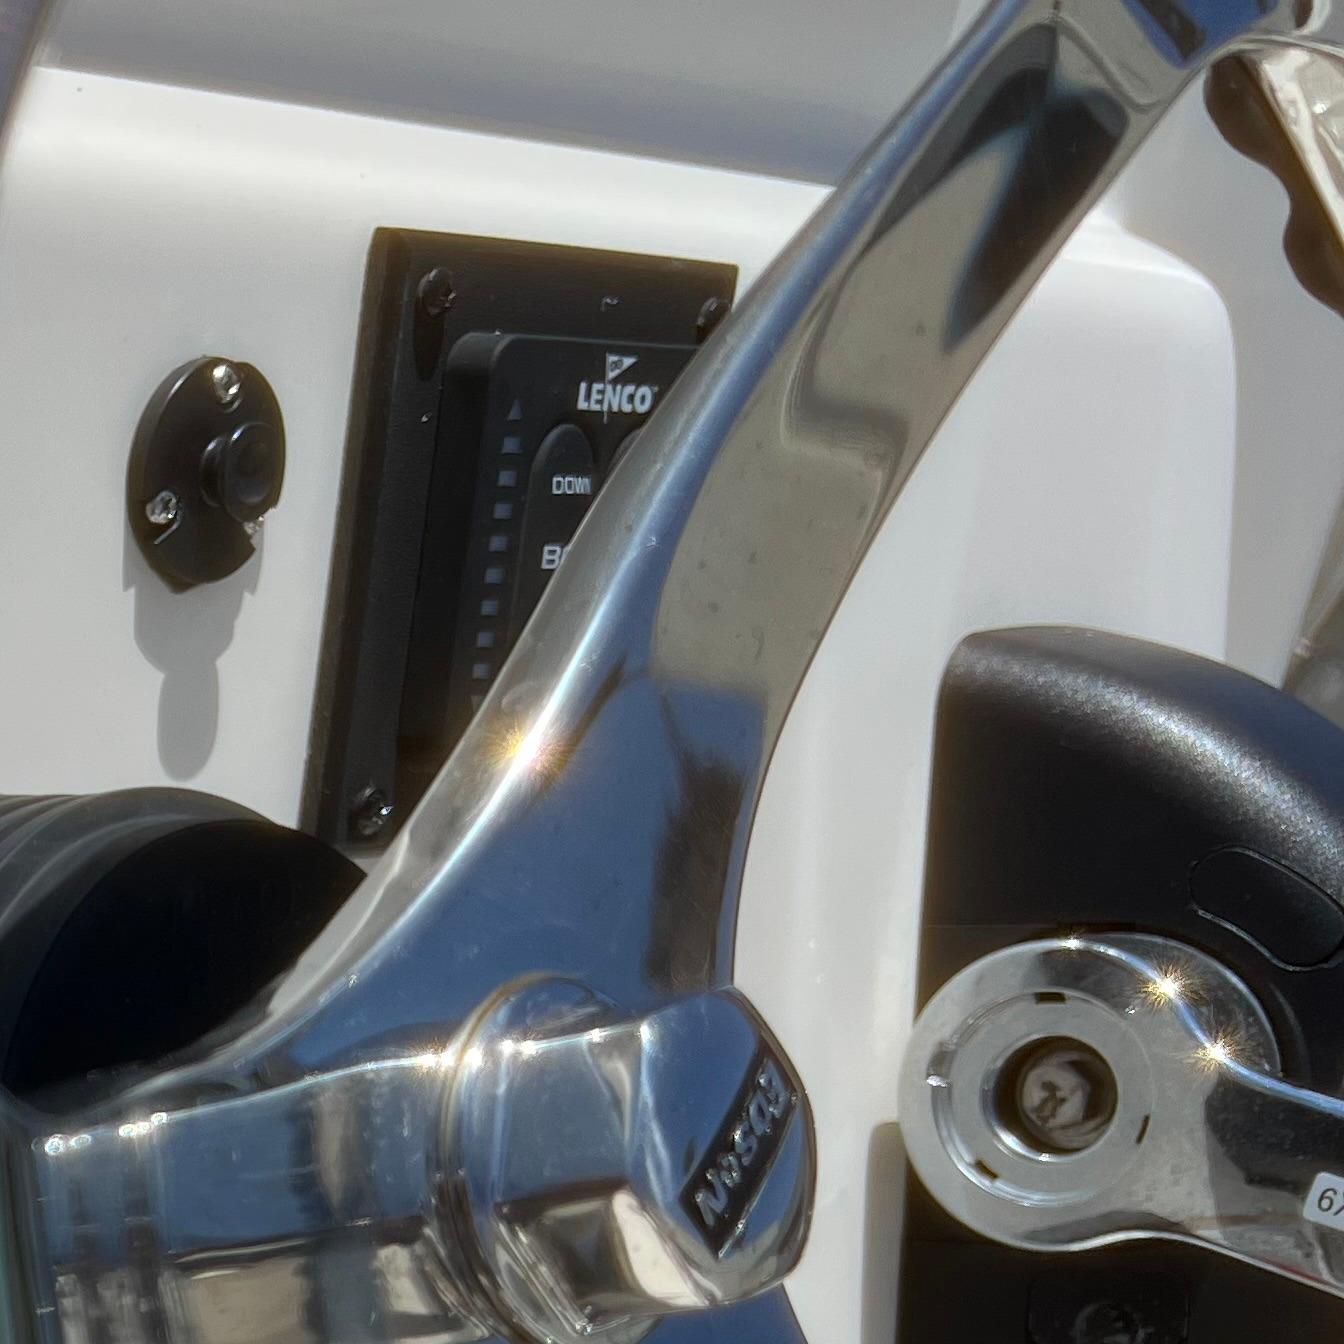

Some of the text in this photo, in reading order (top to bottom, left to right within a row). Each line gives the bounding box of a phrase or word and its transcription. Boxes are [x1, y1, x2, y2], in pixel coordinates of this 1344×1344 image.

[576, 381, 654, 414] LENCO
[551, 475, 591, 496] DOWN
[541, 544, 571, 571] B
[695, 1057, 789, 1228] EDSON
